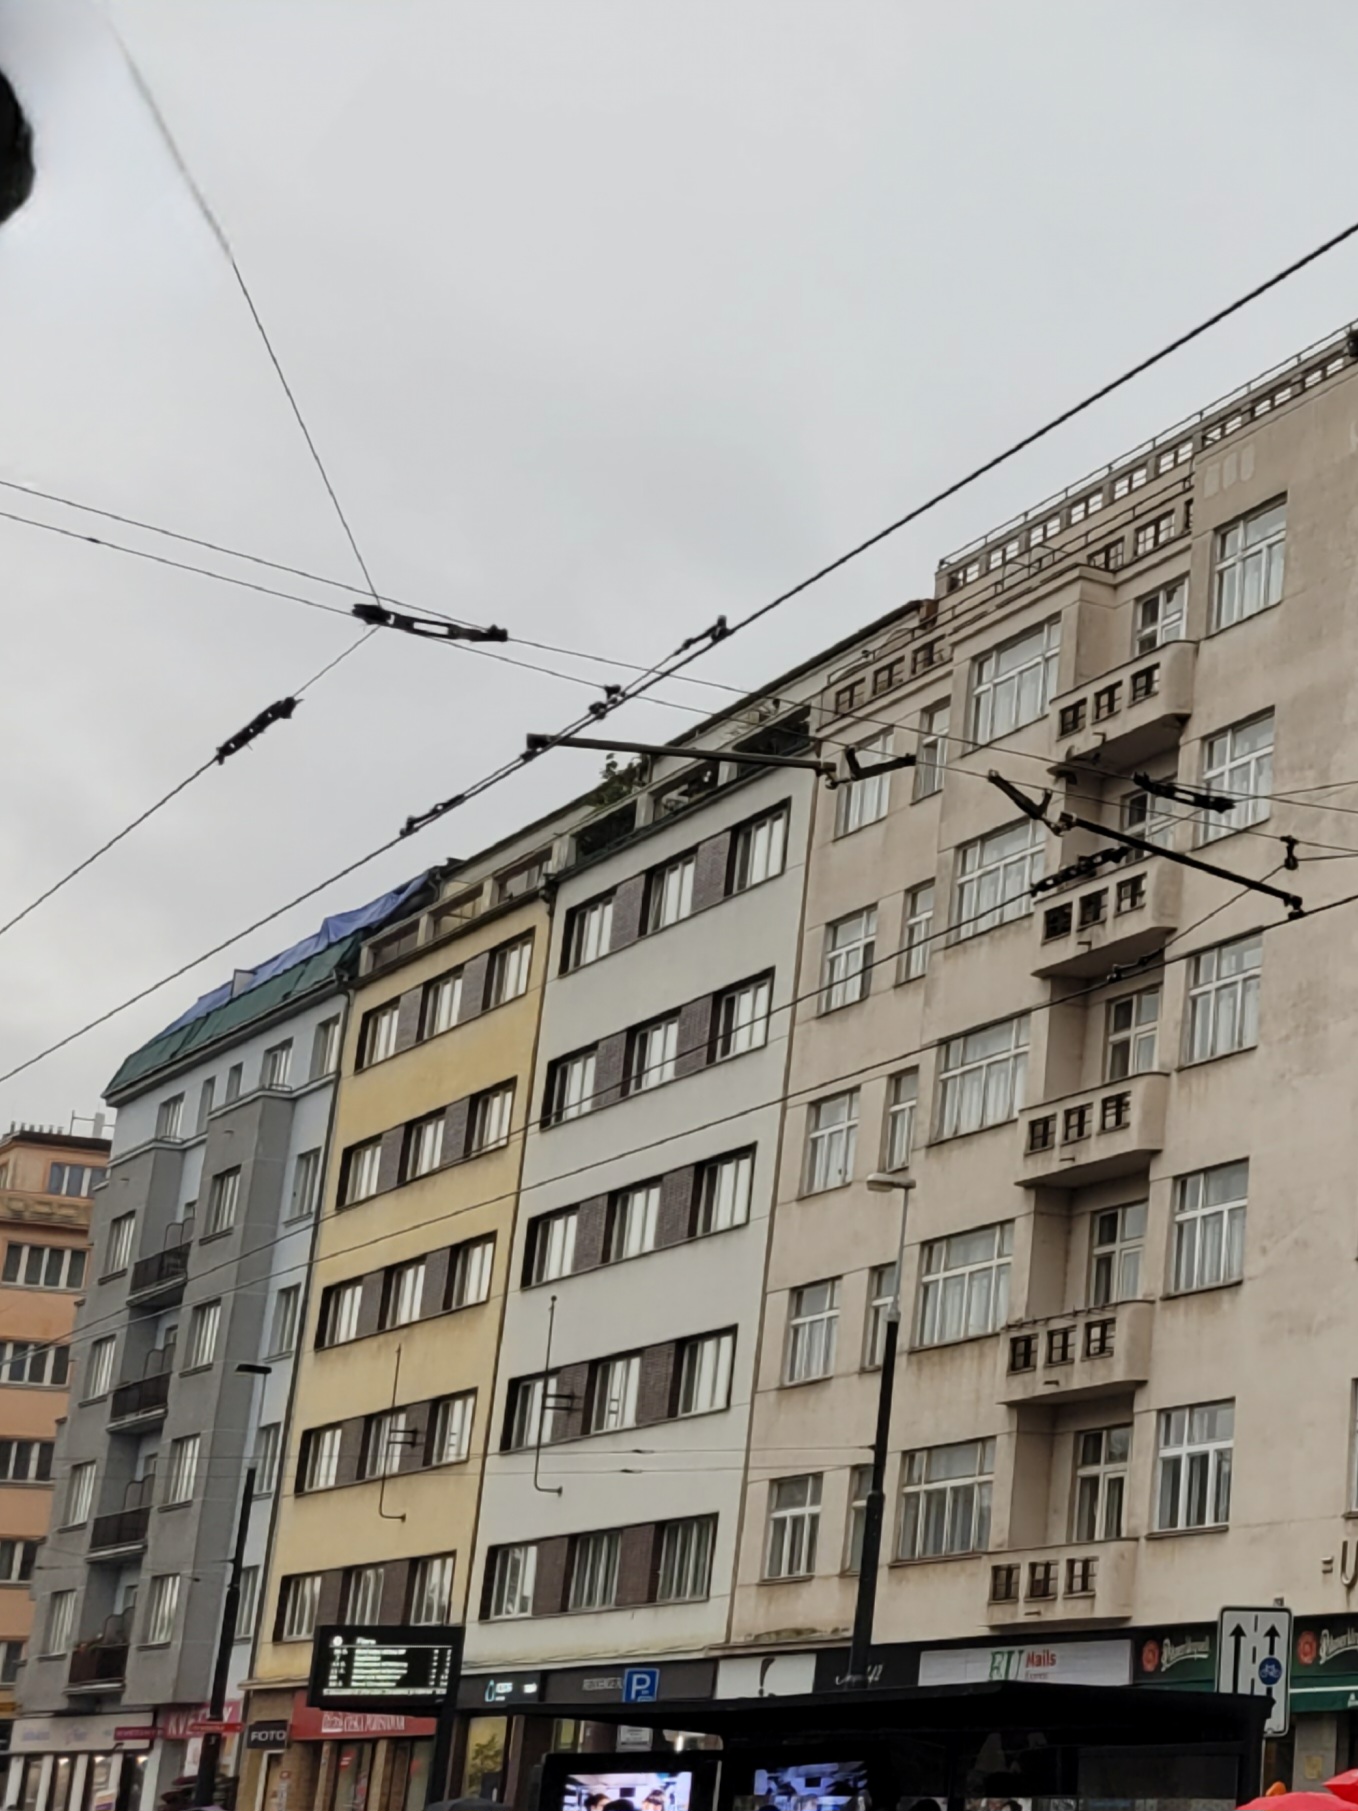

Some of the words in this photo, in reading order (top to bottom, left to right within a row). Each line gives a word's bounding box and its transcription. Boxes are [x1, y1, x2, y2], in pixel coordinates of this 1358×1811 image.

[1025, 1648, 1057, 1668] Nails
[631, 1673, 651, 1700] P
[250, 1730, 286, 1742] FOTO
